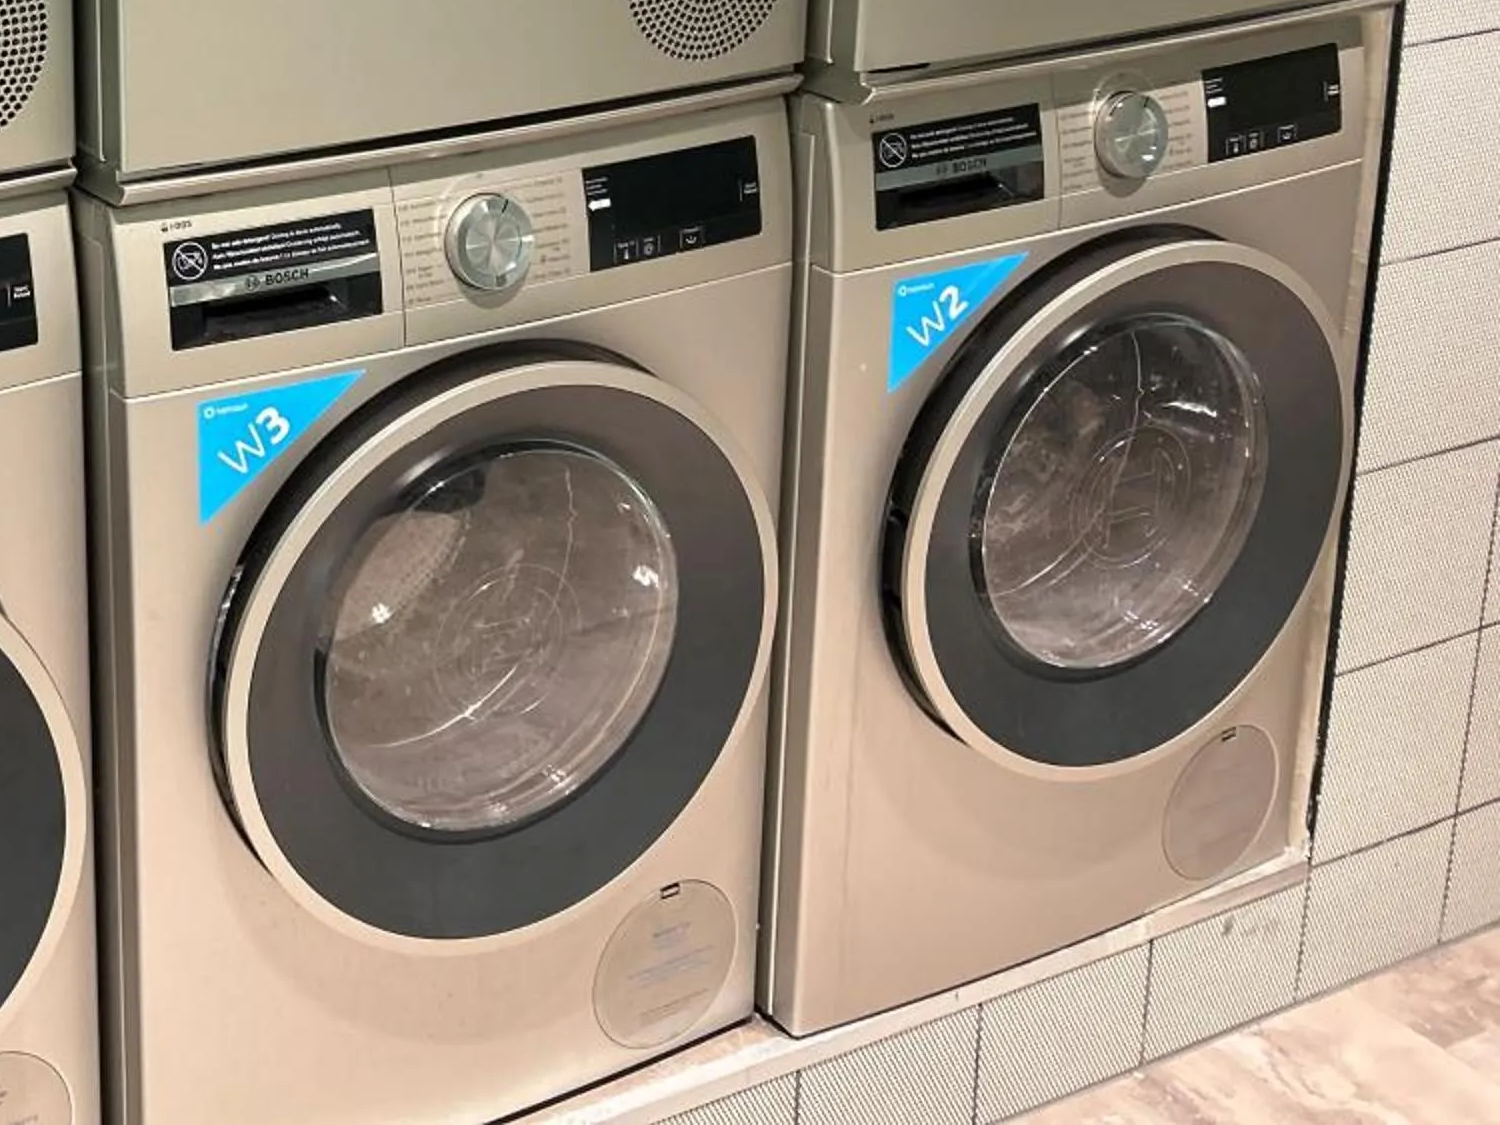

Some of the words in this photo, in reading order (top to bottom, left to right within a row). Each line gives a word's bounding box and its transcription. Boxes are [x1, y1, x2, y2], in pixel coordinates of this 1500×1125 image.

[952, 157, 988, 174] BOSCH
[265, 268, 309, 286] BOSCH
[905, 285, 970, 346] W2
[216, 406, 291, 474] W3
